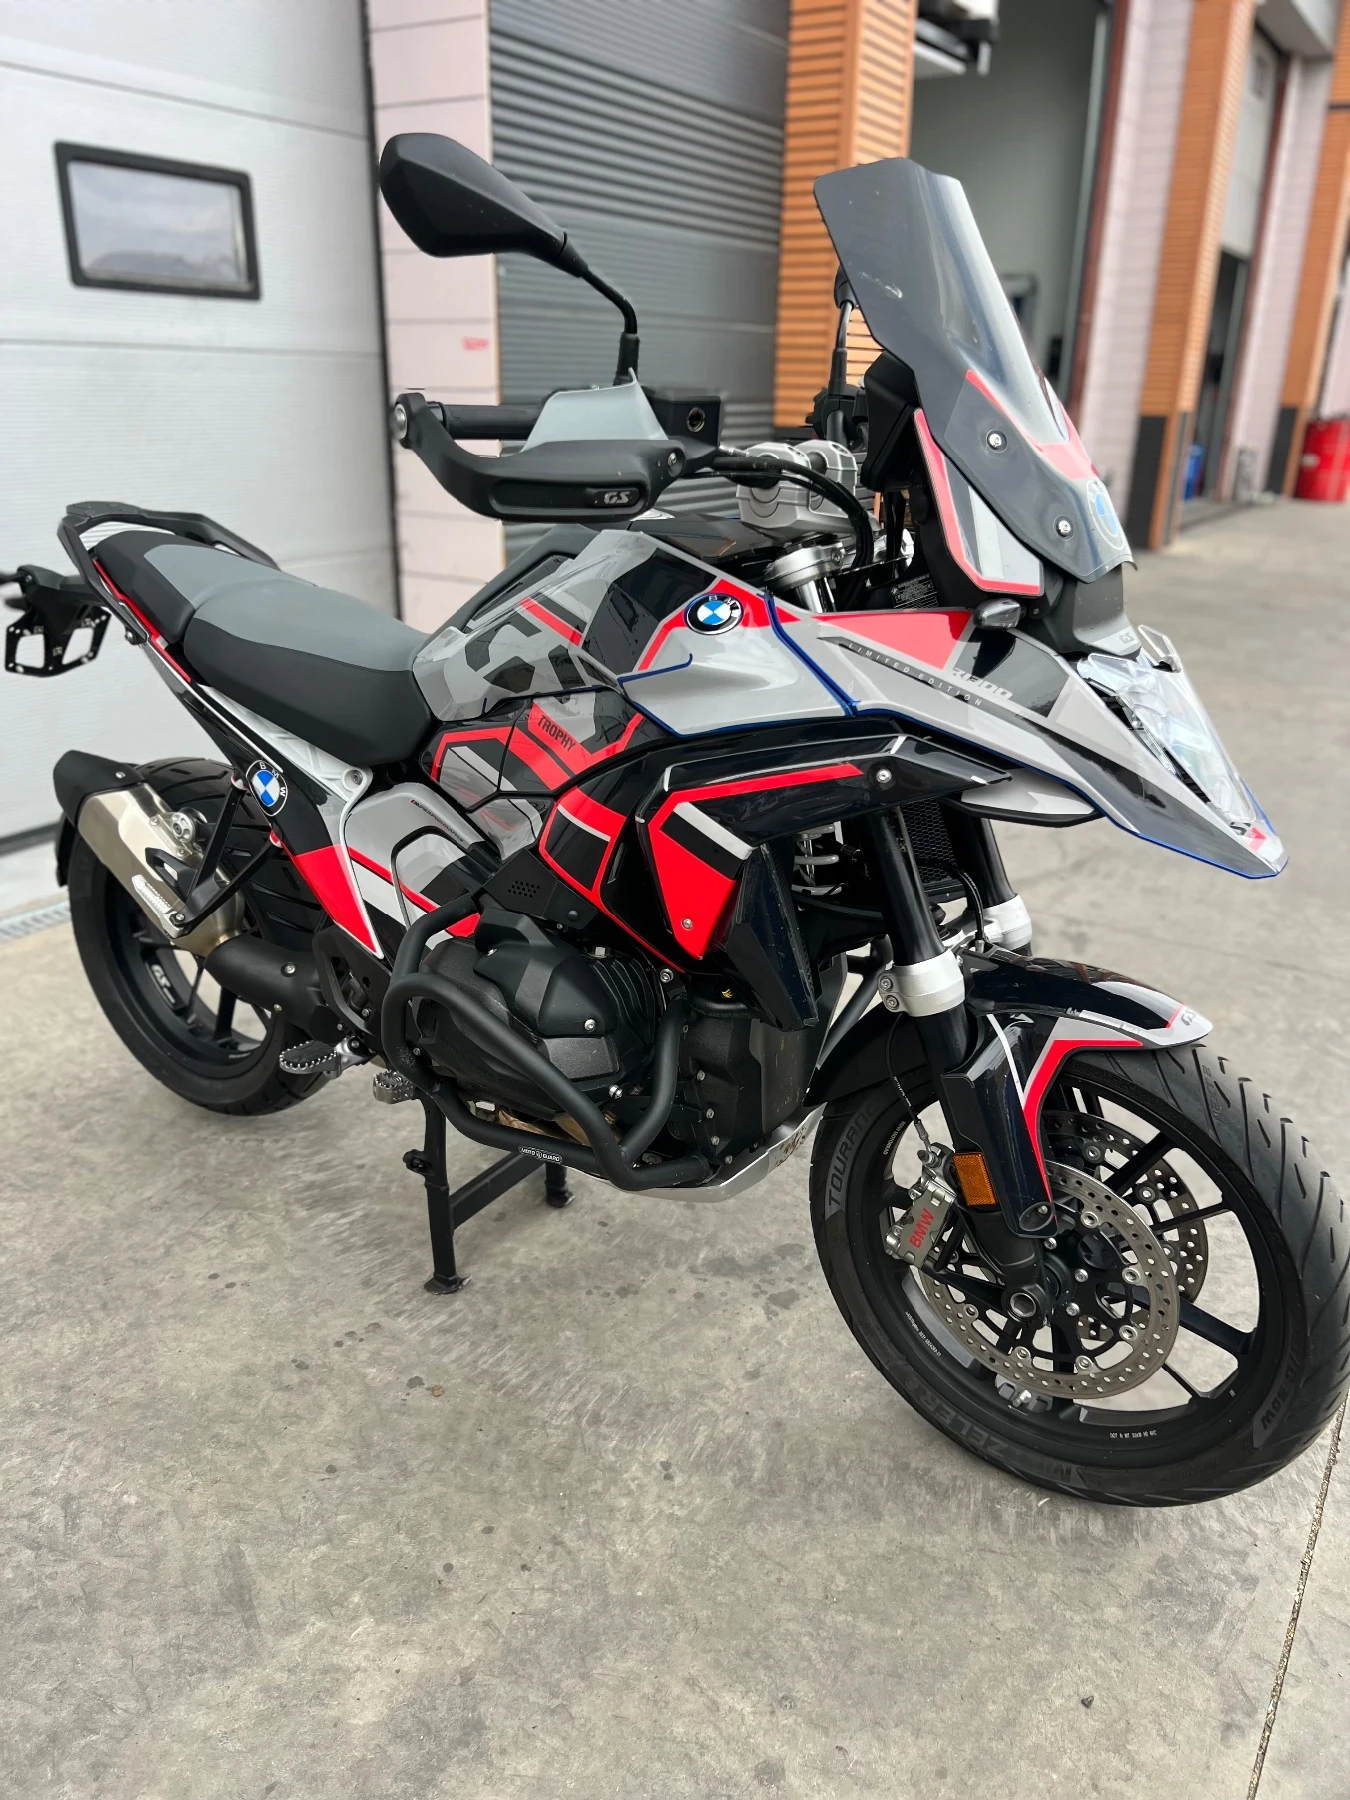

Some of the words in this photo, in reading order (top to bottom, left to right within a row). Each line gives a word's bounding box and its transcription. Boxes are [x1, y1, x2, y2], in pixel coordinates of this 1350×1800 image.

[604, 491, 630, 504] GS
[848, 643, 910, 673] LIMITED
[918, 673, 982, 706] EDITION
[538, 715, 576, 752] TROPHY
[909, 1208, 934, 1248] BMW
